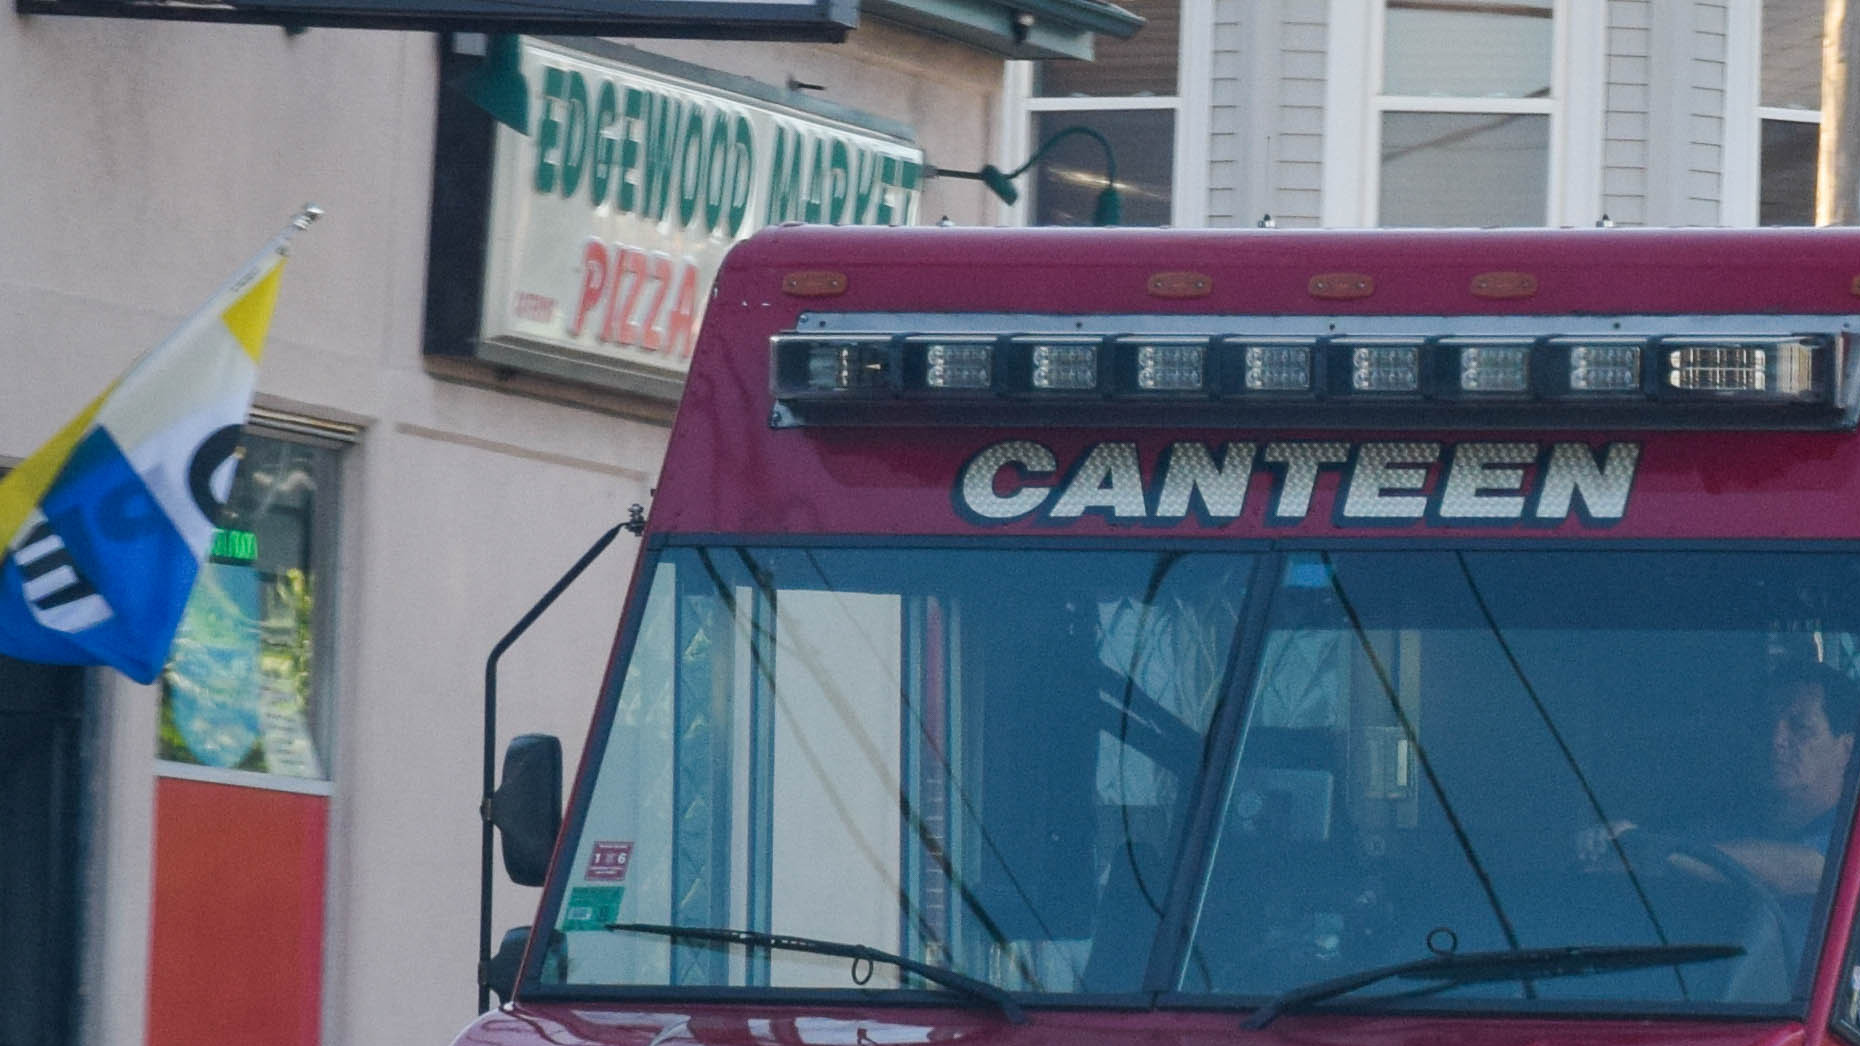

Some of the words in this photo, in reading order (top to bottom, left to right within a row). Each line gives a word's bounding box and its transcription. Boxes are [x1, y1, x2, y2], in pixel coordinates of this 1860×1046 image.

[533, 65, 754, 238] EDGEWOOD
[766, 121, 924, 226] MARKET
[568, 239, 700, 360] PIZZA
[955, 440, 1642, 525] CANTEEN
